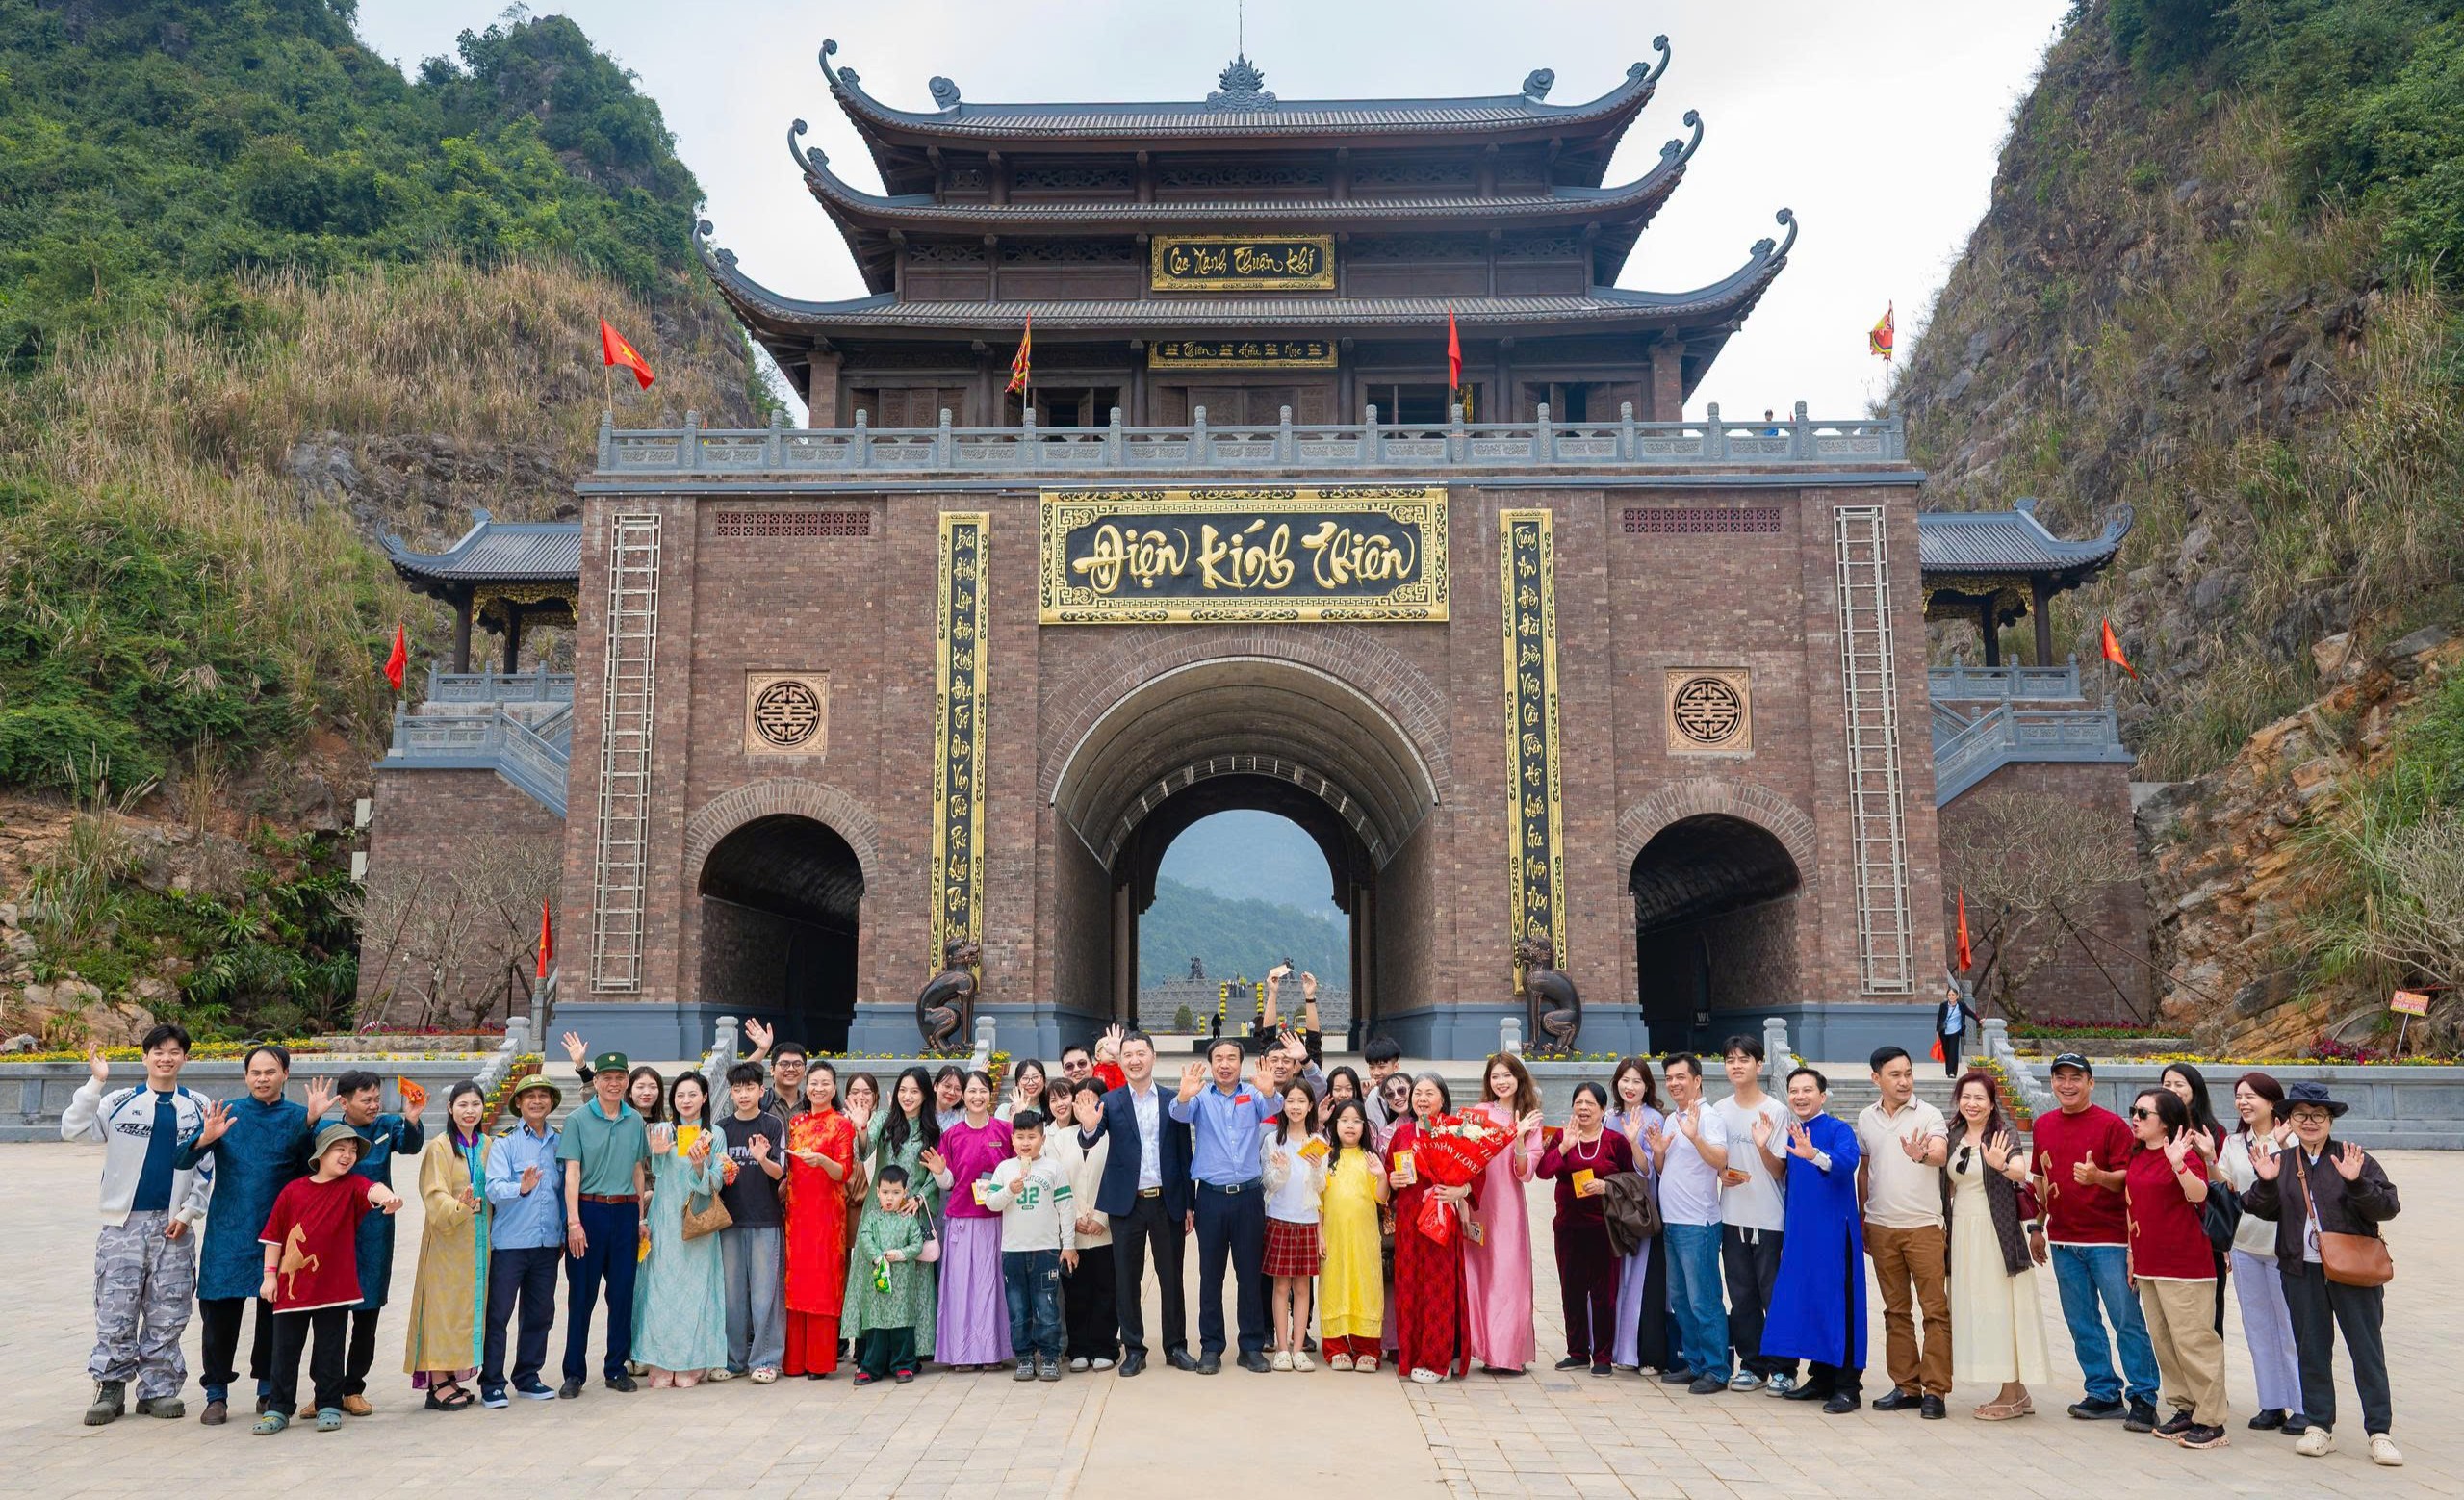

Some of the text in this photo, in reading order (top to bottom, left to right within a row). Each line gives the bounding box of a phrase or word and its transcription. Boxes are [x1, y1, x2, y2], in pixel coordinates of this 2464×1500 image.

[1169, 246, 1316, 275] Cao Xanh Thuận Khí
[954, 527, 975, 552] Bái
[1514, 525, 1537, 552] Tràng
[953, 556, 976, 581] Đính
[1071, 518, 1416, 594] Điện Kính Thiên
[1517, 555, 1537, 579] An
[1517, 584, 1539, 611] Đền
[1518, 612, 1540, 636] Đài
[952, 645, 973, 671] Kính
[1519, 643, 1541, 668] Bền
[951, 675, 973, 702] Địa
[1523, 701, 1540, 727] Cầu
